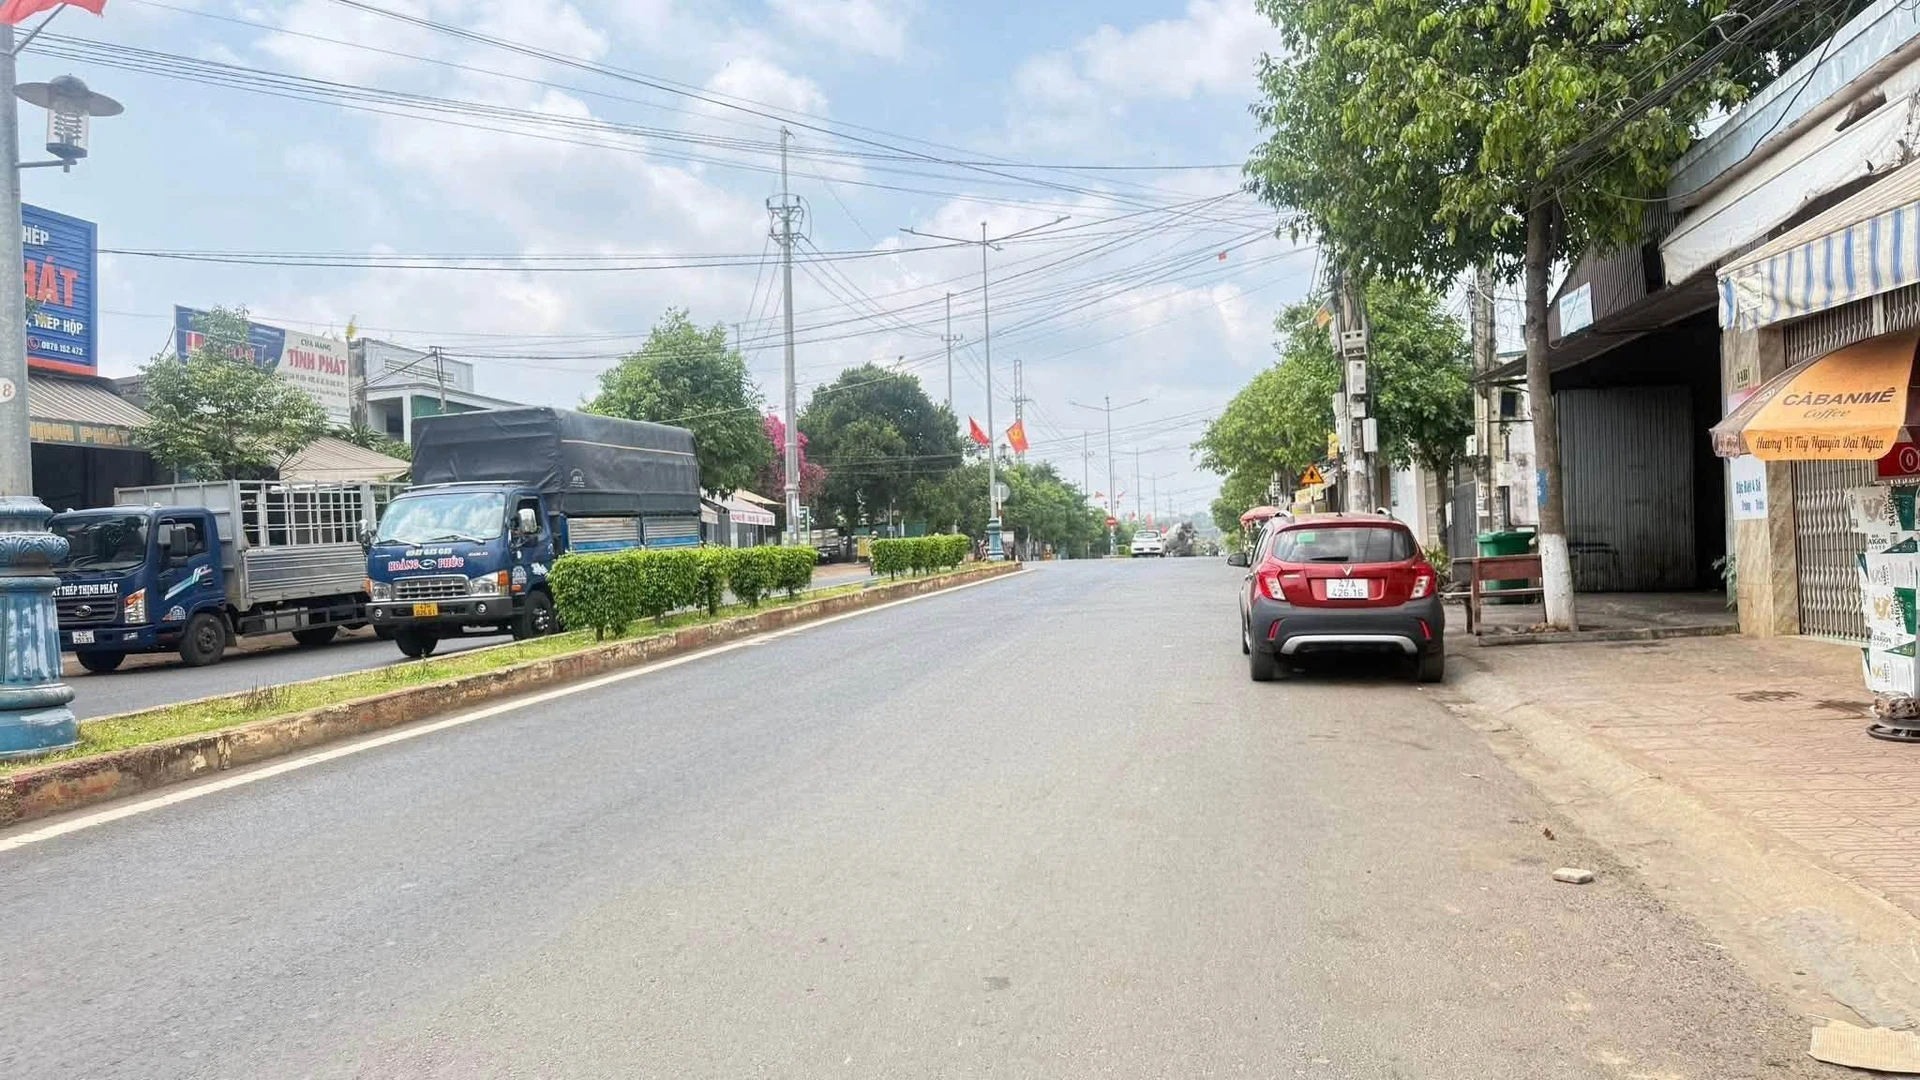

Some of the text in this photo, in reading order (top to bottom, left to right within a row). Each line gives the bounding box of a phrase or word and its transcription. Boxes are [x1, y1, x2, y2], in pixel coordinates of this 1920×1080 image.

[24, 256, 78, 307] HÁT
[318, 354, 347, 376] PHÁT
[1784, 436, 1793, 452] Vị
[61, 583, 77, 597] THÉP
[100, 581, 118, 594] PHÁT
[1339, 579, 1357, 588] 47A
